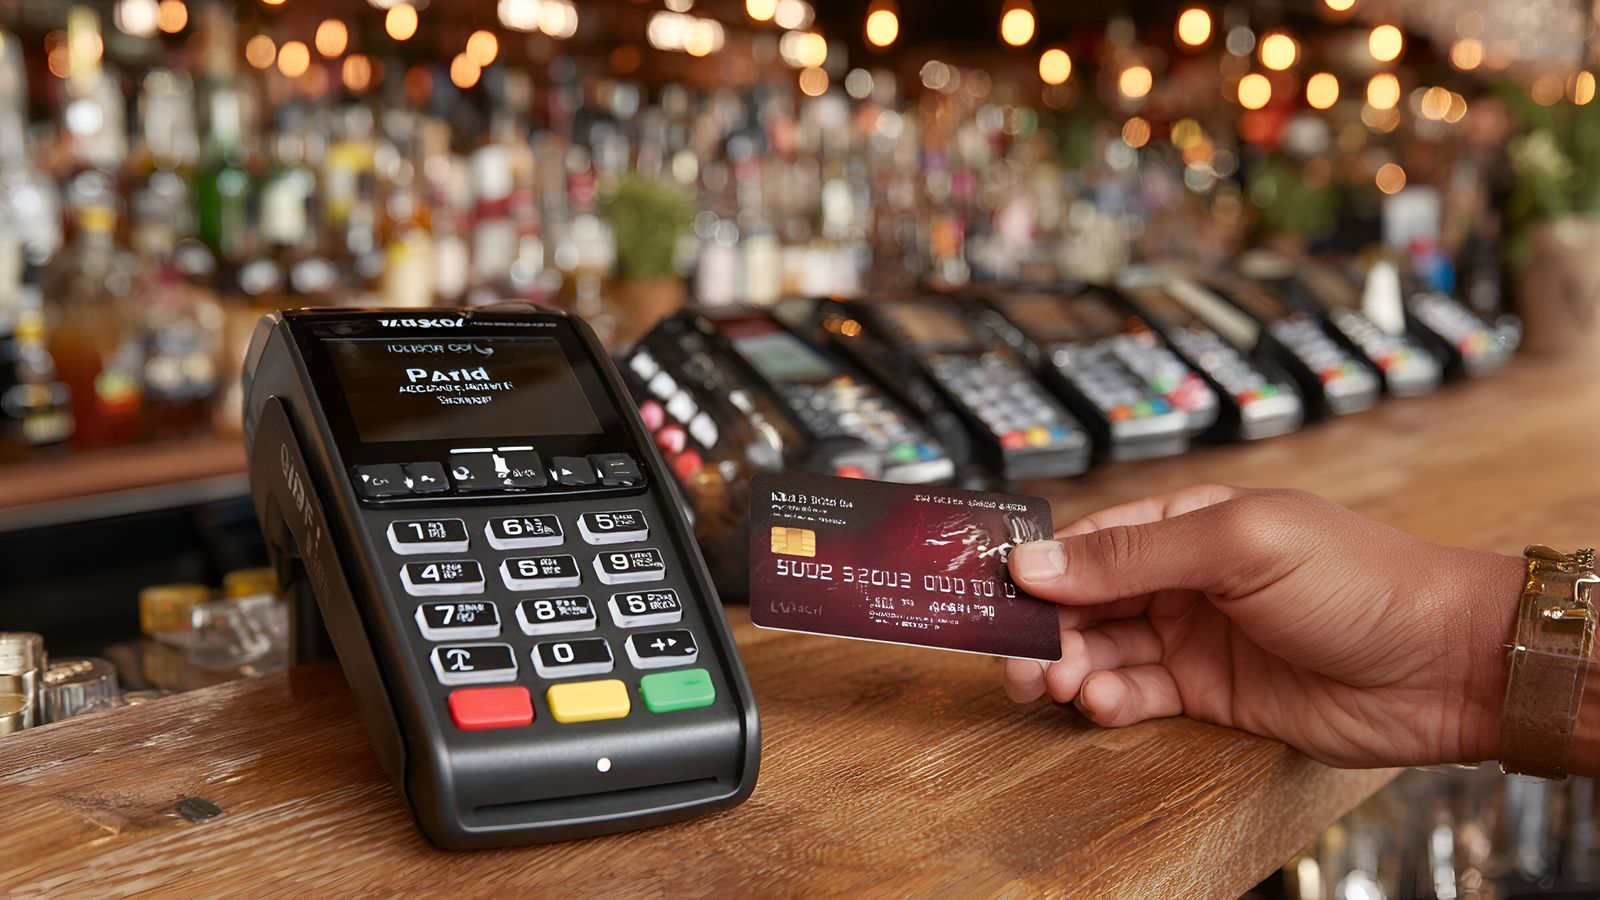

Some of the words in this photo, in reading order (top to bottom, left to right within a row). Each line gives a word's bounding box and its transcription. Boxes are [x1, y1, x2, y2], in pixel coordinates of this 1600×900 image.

[503, 519, 523, 535] 6
[595, 514, 615, 530] 5
[610, 554, 630, 570] 9
[421, 564, 440, 582] 4
[434, 605, 455, 625] 7
[534, 600, 556, 620] 8
